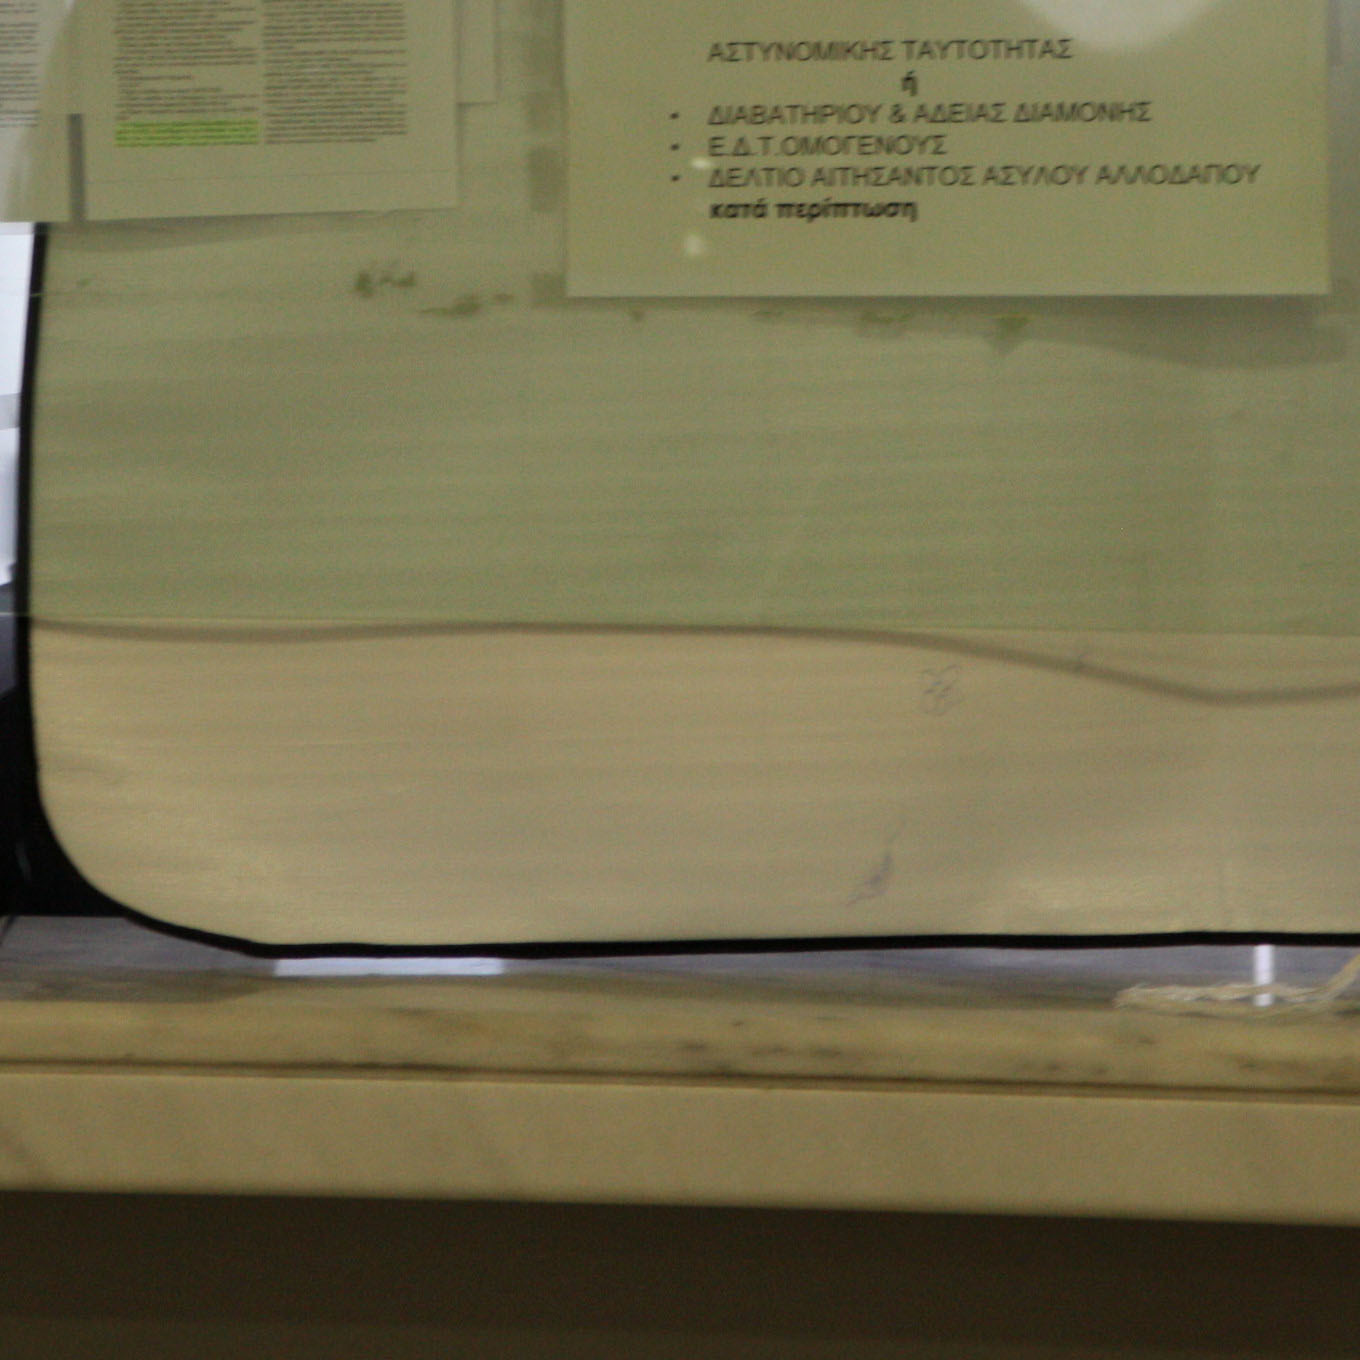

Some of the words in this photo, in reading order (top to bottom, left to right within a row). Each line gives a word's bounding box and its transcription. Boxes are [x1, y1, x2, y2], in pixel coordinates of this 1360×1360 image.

[706, 38, 896, 64] ΑΣΤΥΝΟΜΙΚΗΣ
[902, 36, 1076, 62] ΤΑΥΤΟΤΗΤΑΣ
[706, 102, 884, 128] ΔΙΑΒΑΤΗΡΙΟΥ
[888, 102, 907, 126] &
[912, 100, 1009, 126] ΑΔΕΙΑΣ
[1012, 99, 1154, 126] ΔΙΑΜΟΝΗΣ
[706, 166, 807, 191] ΔΕΛΤΙΟ
[811, 165, 977, 189] ΑΙΤΗΣΑΝΤΟΣ
[982, 164, 1090, 189] ΑΣΥΛΟΥ
[1094, 162, 1264, 188] ΑΛΛΟΔΑΠΟΥ
[708, 198, 769, 222] κατά
[774, 196, 921, 224] περίπτωση
